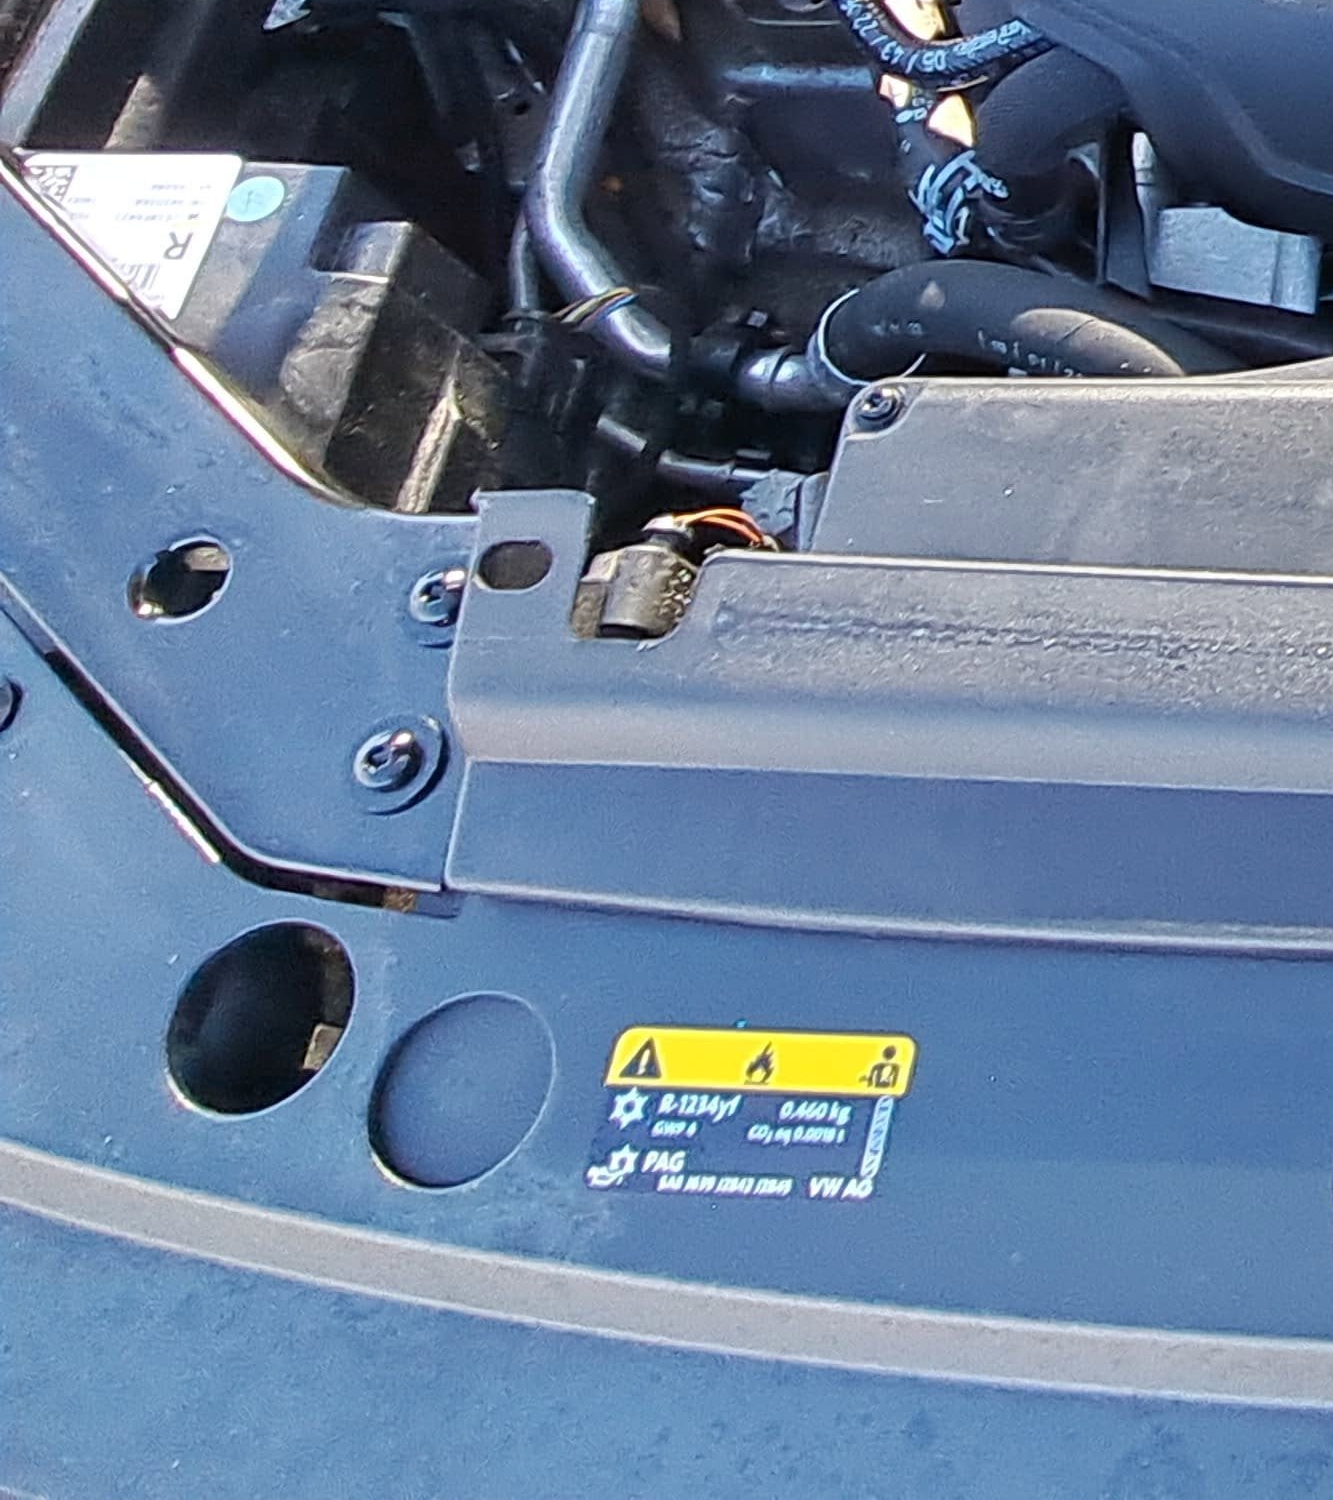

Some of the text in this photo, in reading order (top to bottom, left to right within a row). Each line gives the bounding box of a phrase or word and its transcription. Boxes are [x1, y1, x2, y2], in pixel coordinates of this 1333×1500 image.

[657, 1093, 742, 1123] R-1234yf
[829, 1100, 852, 1125] kg
[641, 1150, 686, 1173] PAG
[809, 1177, 844, 1198] VW
